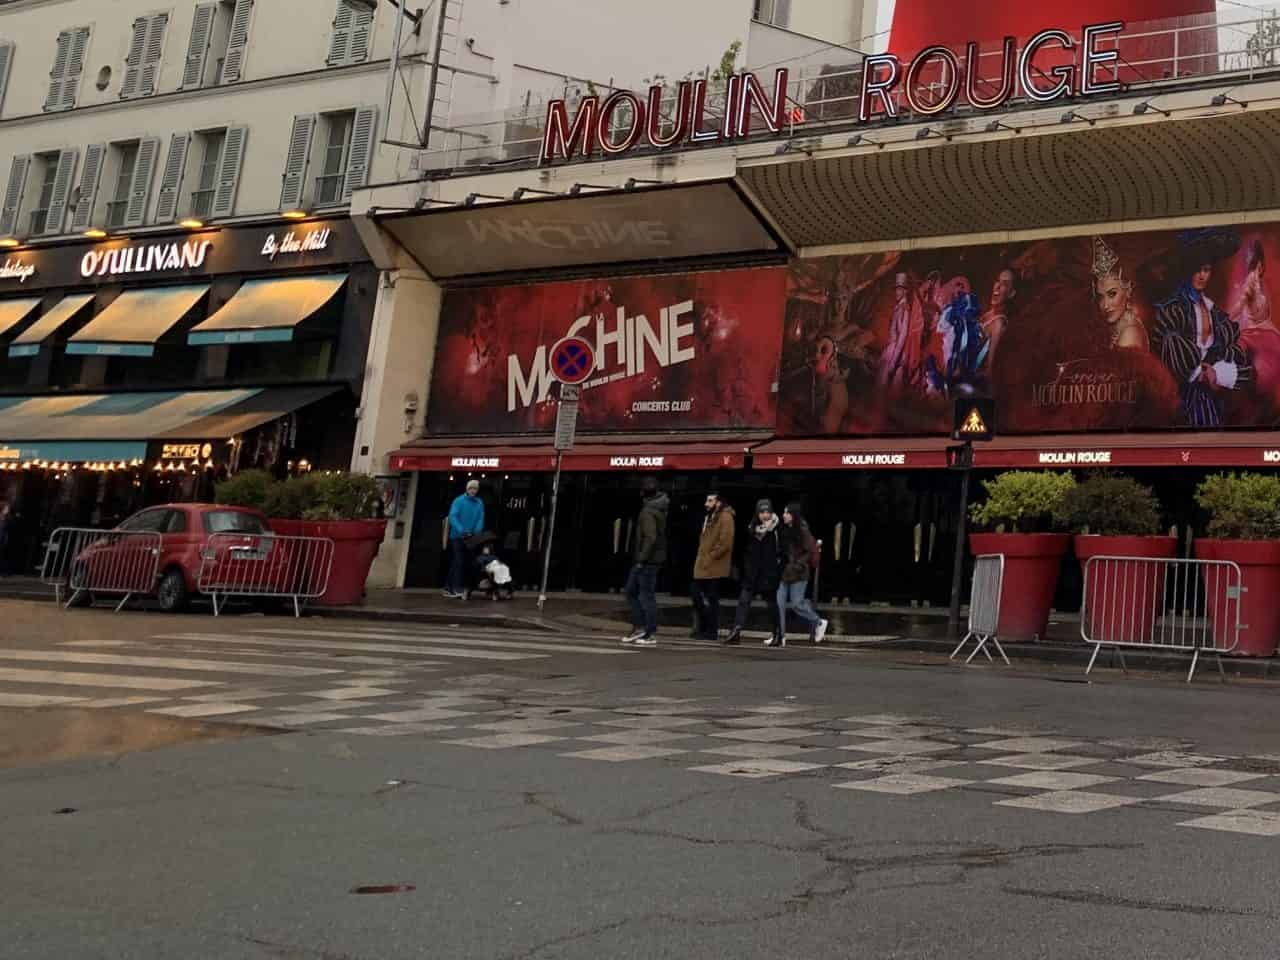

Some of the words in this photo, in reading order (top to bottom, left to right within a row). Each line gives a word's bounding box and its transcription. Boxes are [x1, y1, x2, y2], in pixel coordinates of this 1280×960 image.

[537, 68, 788, 166] MOULIN
[859, 21, 1124, 121] ROUGE
[261, 233, 280, 260] By
[280, 231, 301, 253] the
[301, 227, 330, 251] Mill
[81, 240, 208, 277] O'SULLIVANS
[1032, 383, 1083, 406] MOULIN
[1086, 380, 1136, 403] ROUGE
[632, 401, 669, 412] CONCERTS
[671, 401, 691, 411] CLUB
[610, 457, 636, 466] MOULIN
[638, 456, 664, 466] ROUGE
[842, 455, 874, 465] MOULIN
[875, 454, 905, 464] ROUGE
[1039, 453, 1076, 463] MOULIN
[1078, 452, 1111, 463] ROUGE
